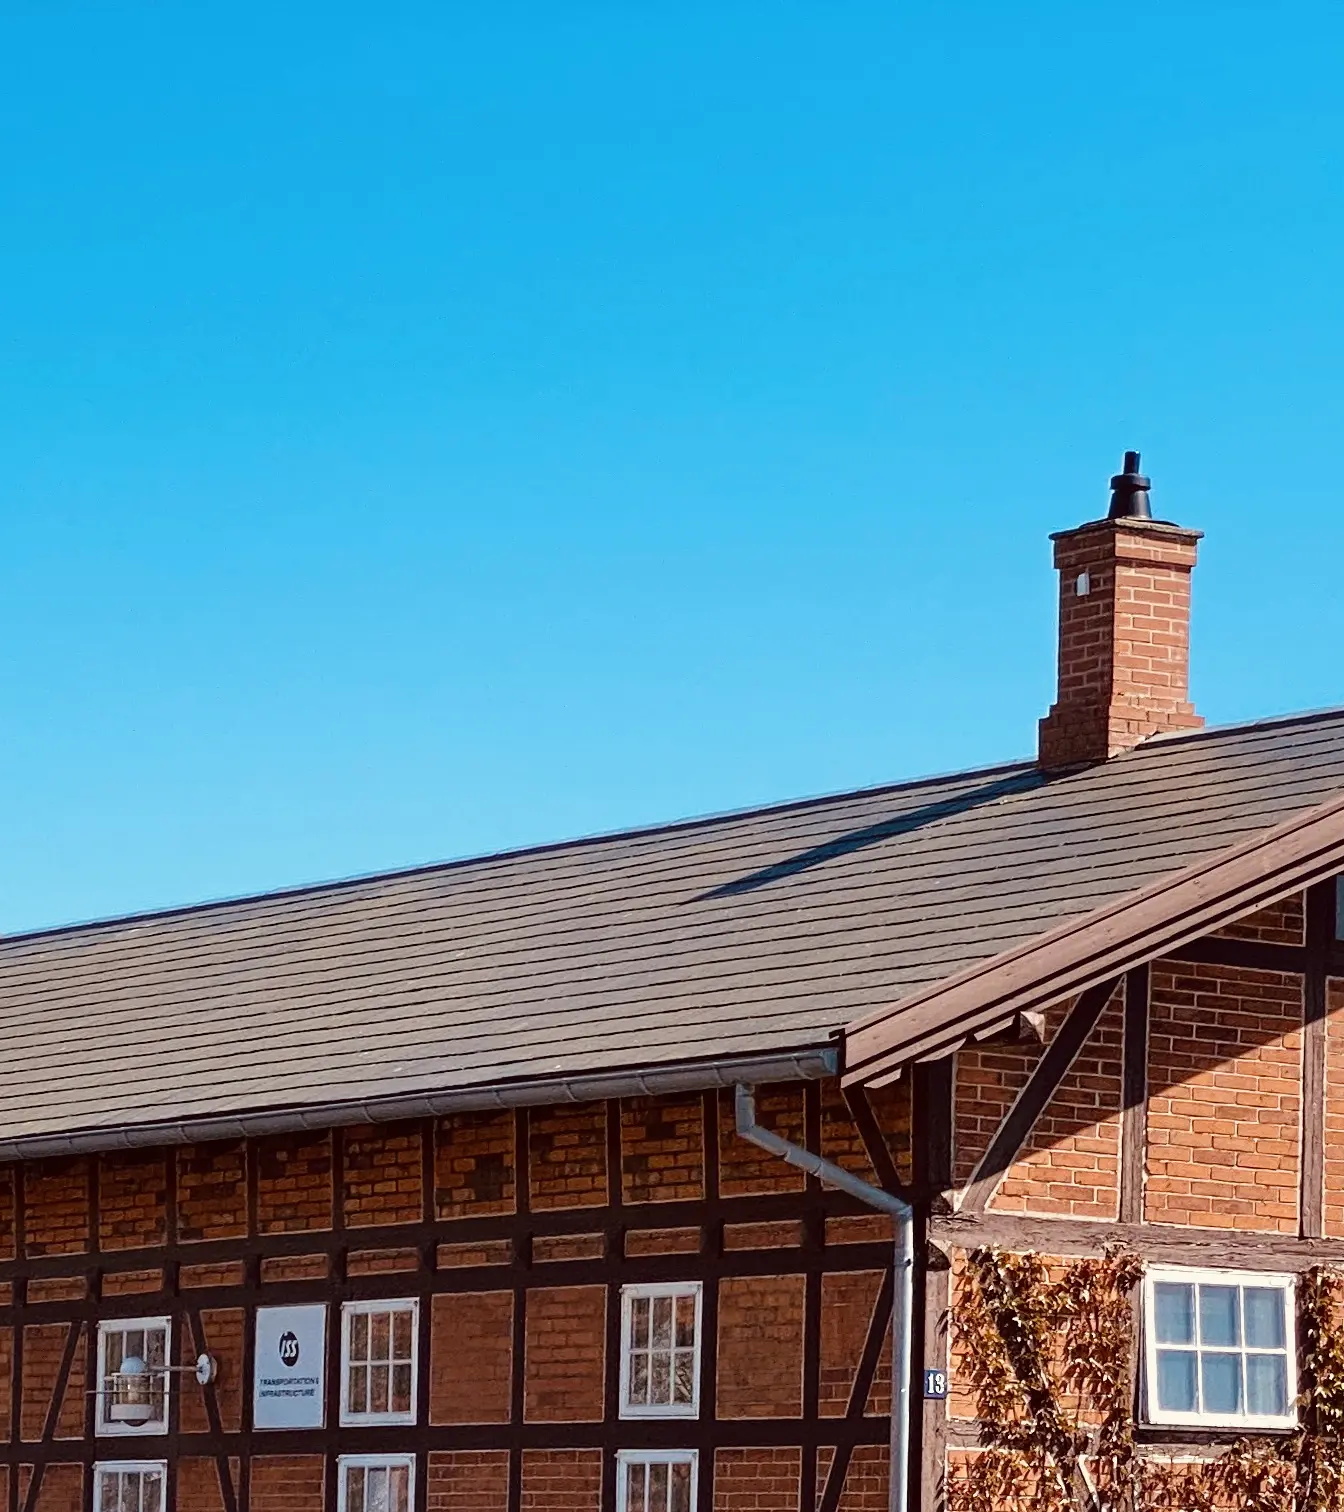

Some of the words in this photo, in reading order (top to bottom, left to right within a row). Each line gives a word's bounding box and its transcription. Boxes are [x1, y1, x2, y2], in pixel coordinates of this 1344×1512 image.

[259, 1377, 315, 1386] TRANSPORTATION
[928, 1372, 945, 1394] 13
[258, 1388, 315, 1398] INFRASTRUCTURE
